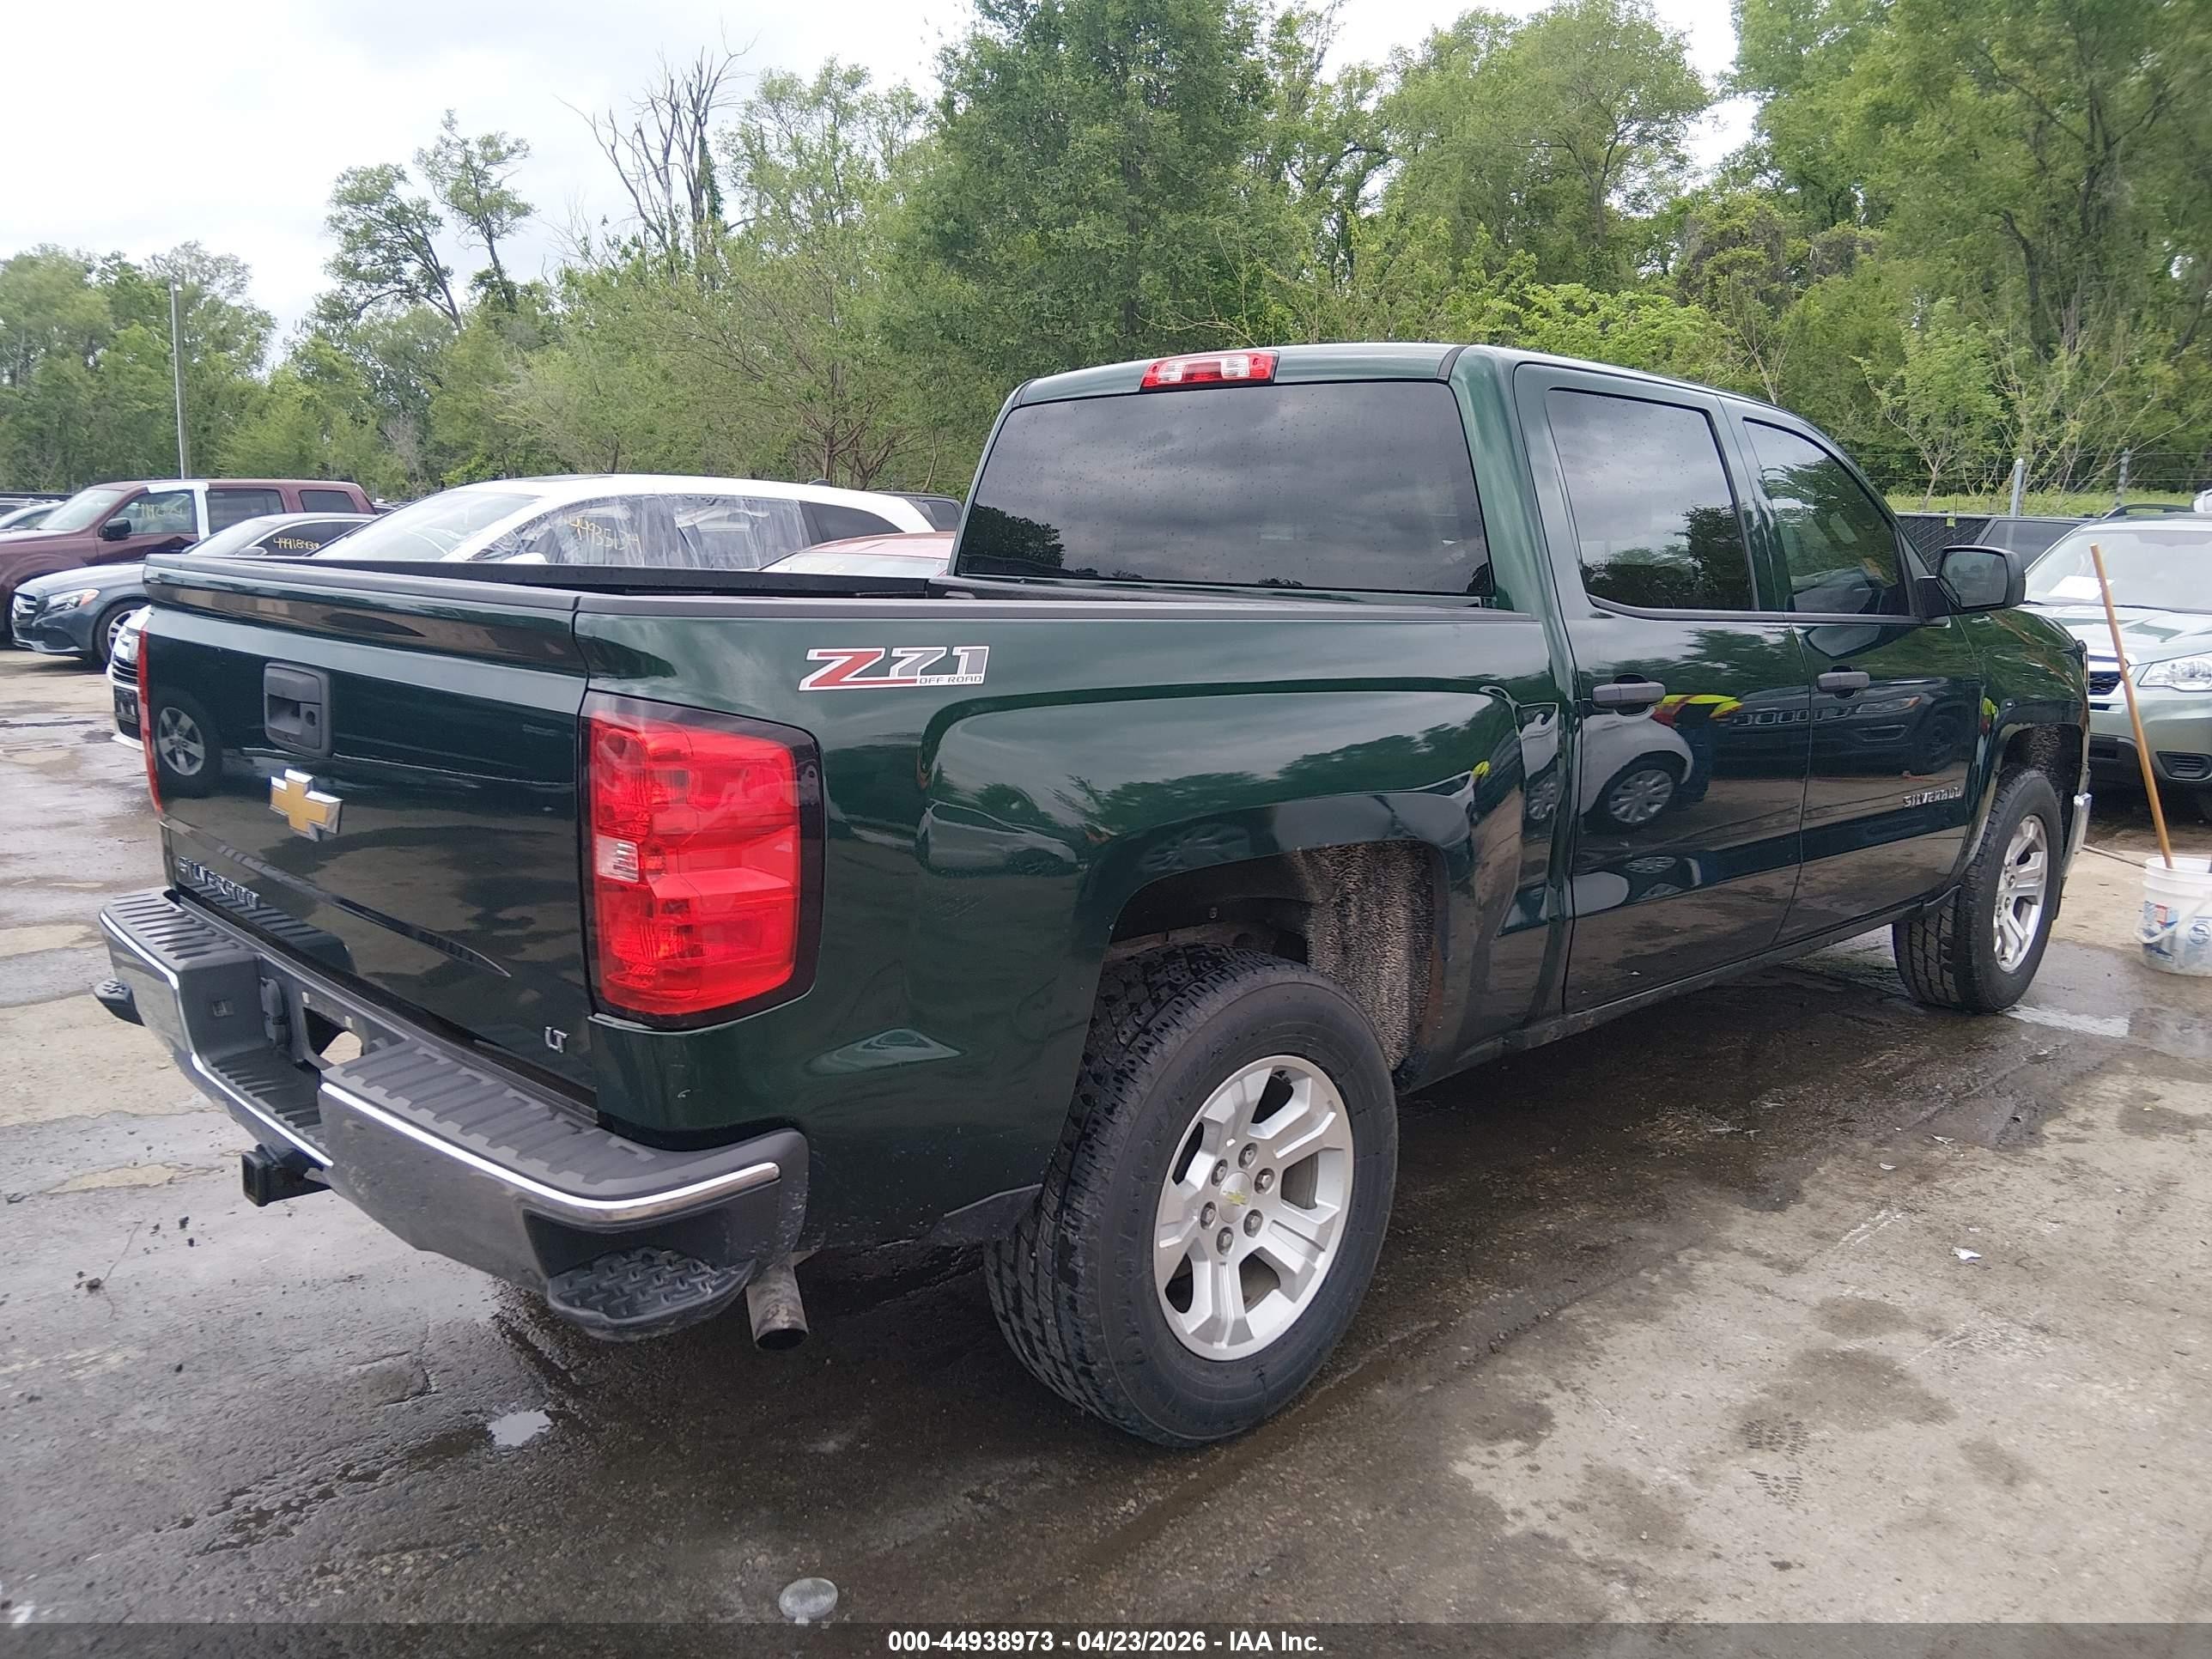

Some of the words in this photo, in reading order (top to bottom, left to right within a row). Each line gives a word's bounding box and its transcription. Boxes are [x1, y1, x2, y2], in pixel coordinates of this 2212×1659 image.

[798, 646, 989, 691] Z71
[919, 677, 944, 685] OFF
[947, 675, 982, 684] ROAD
[1904, 787, 1961, 807] SILVERADO
[544, 1026, 568, 1054] LT
